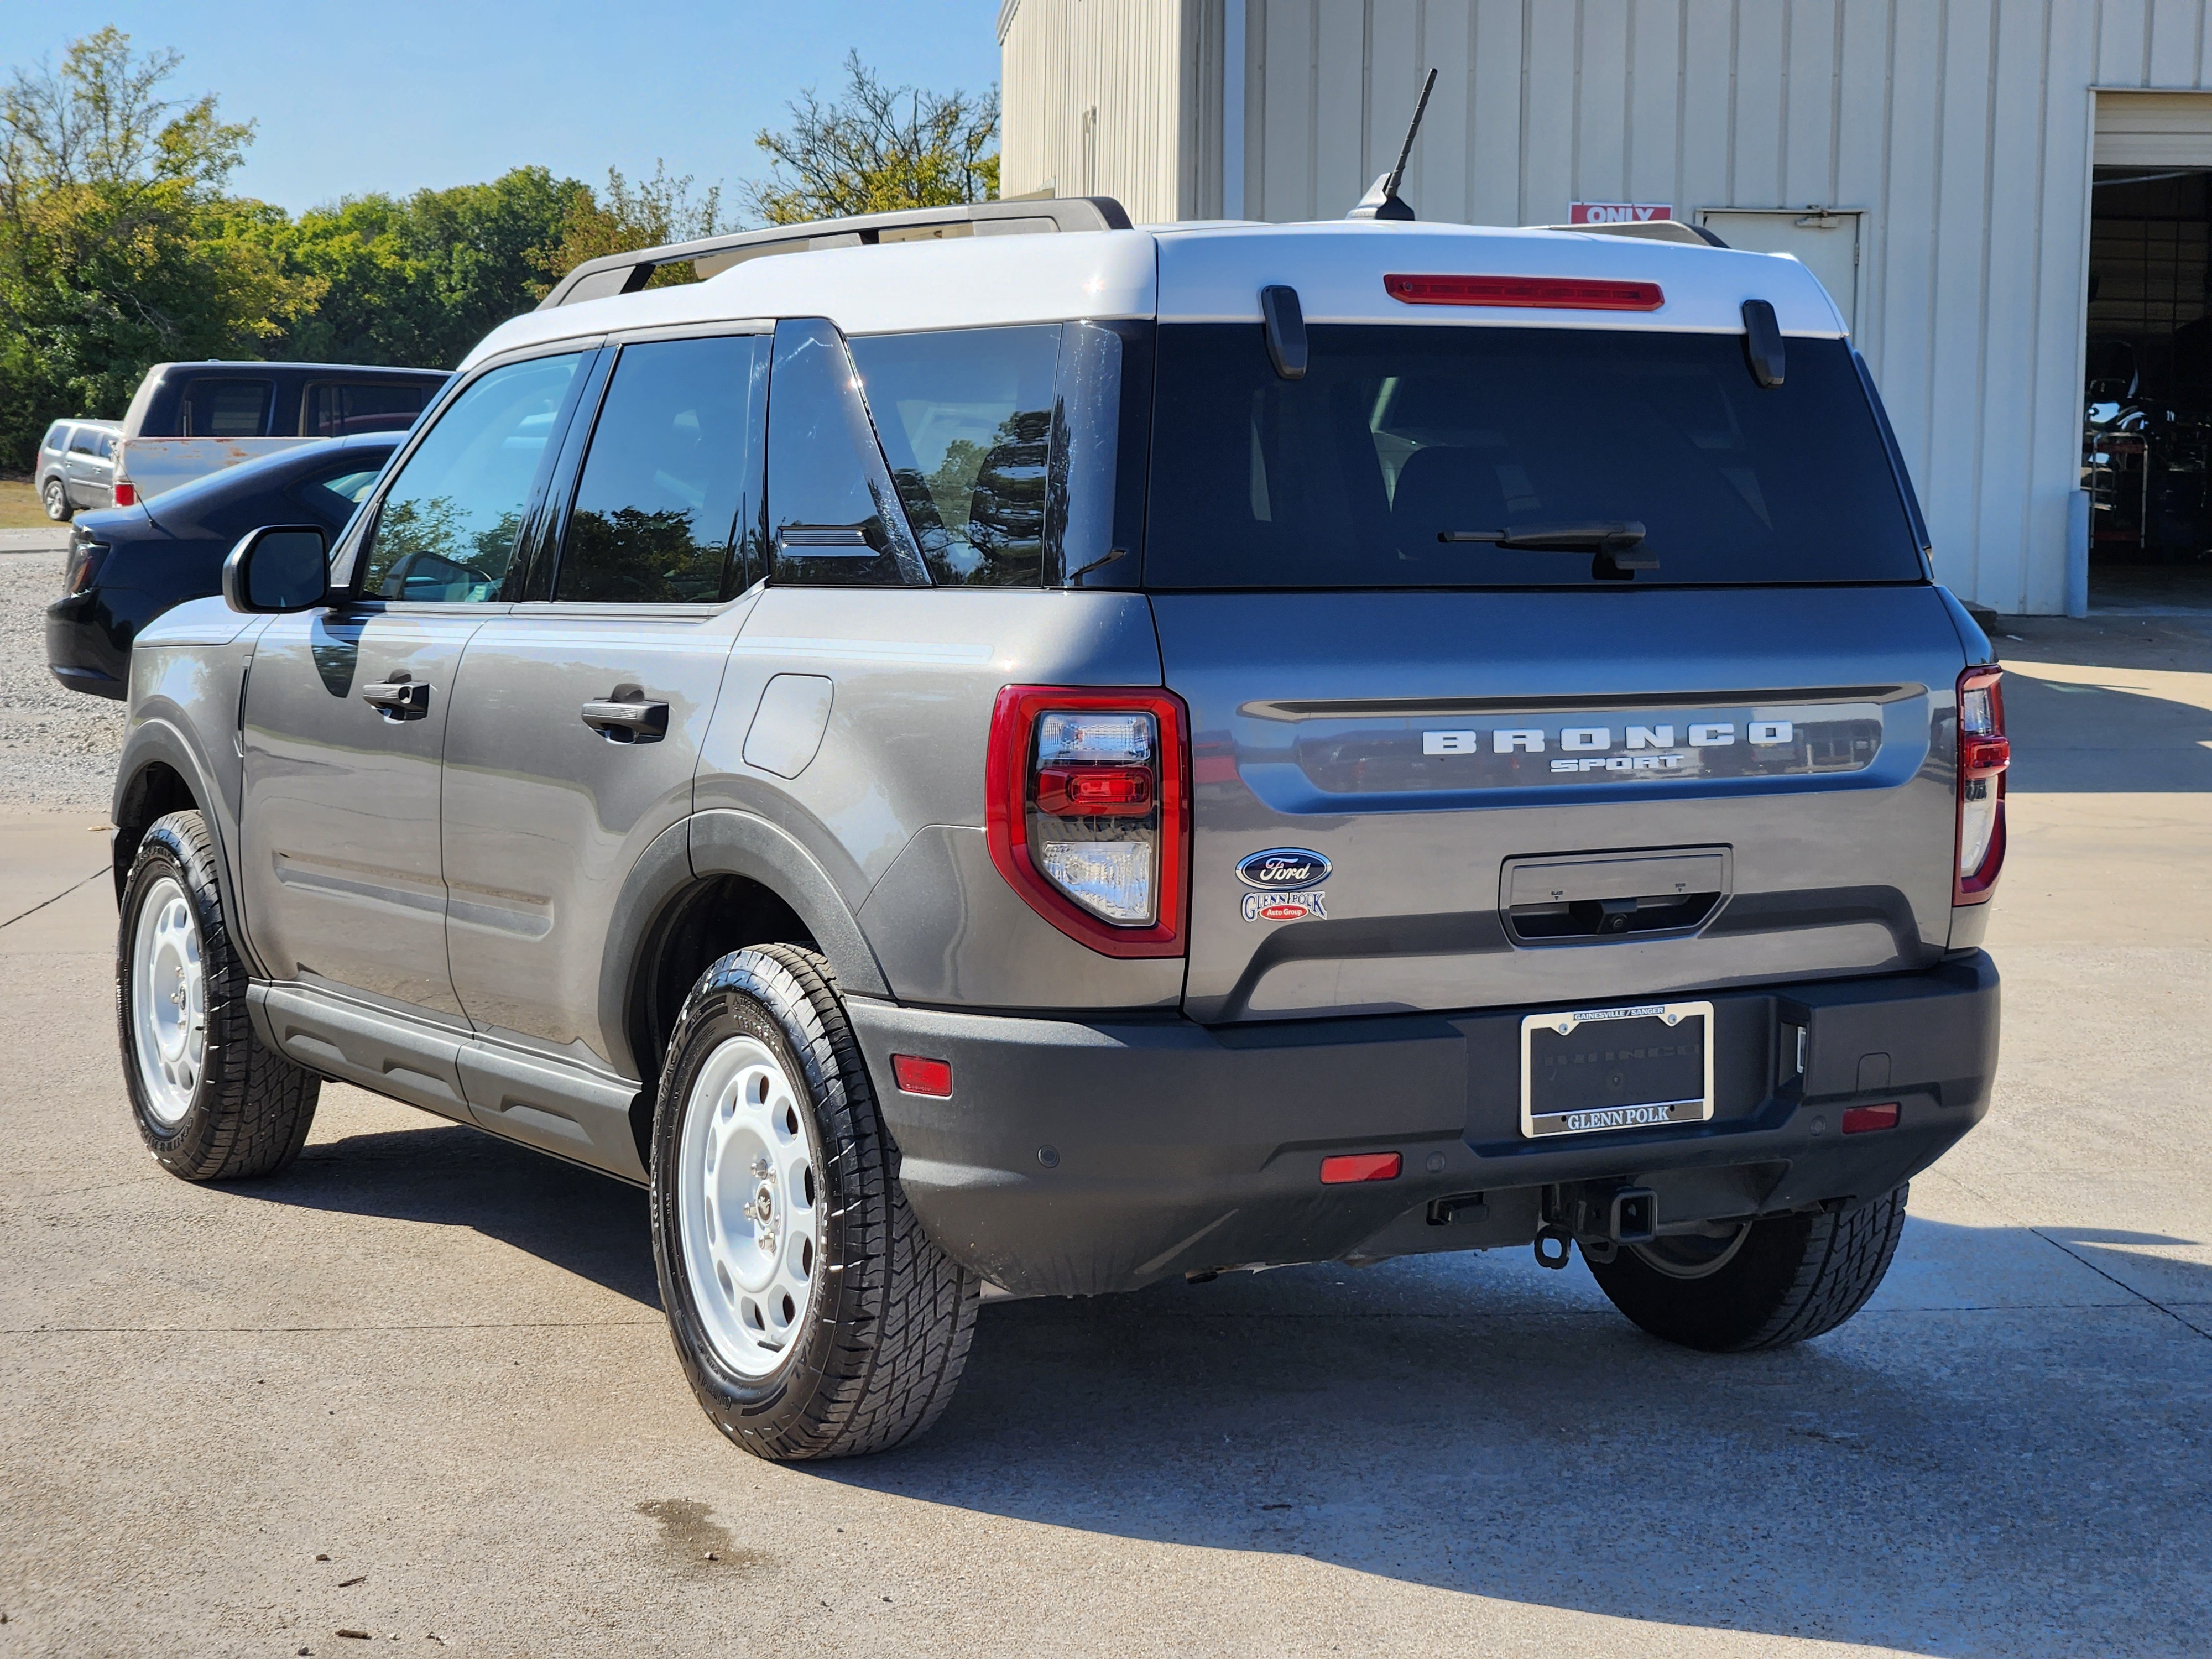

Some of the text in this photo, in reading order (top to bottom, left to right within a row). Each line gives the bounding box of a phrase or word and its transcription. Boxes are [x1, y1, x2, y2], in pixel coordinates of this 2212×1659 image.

[1422, 721, 1793, 755] BRONCO
[1550, 755, 1683, 773] SPORT
[1260, 857, 1311, 880] Ford
[1244, 893, 1325, 920] GLENN POLK
[1283, 909, 1302, 917] Group
[1567, 1106, 1670, 1130] GLENN POLK
